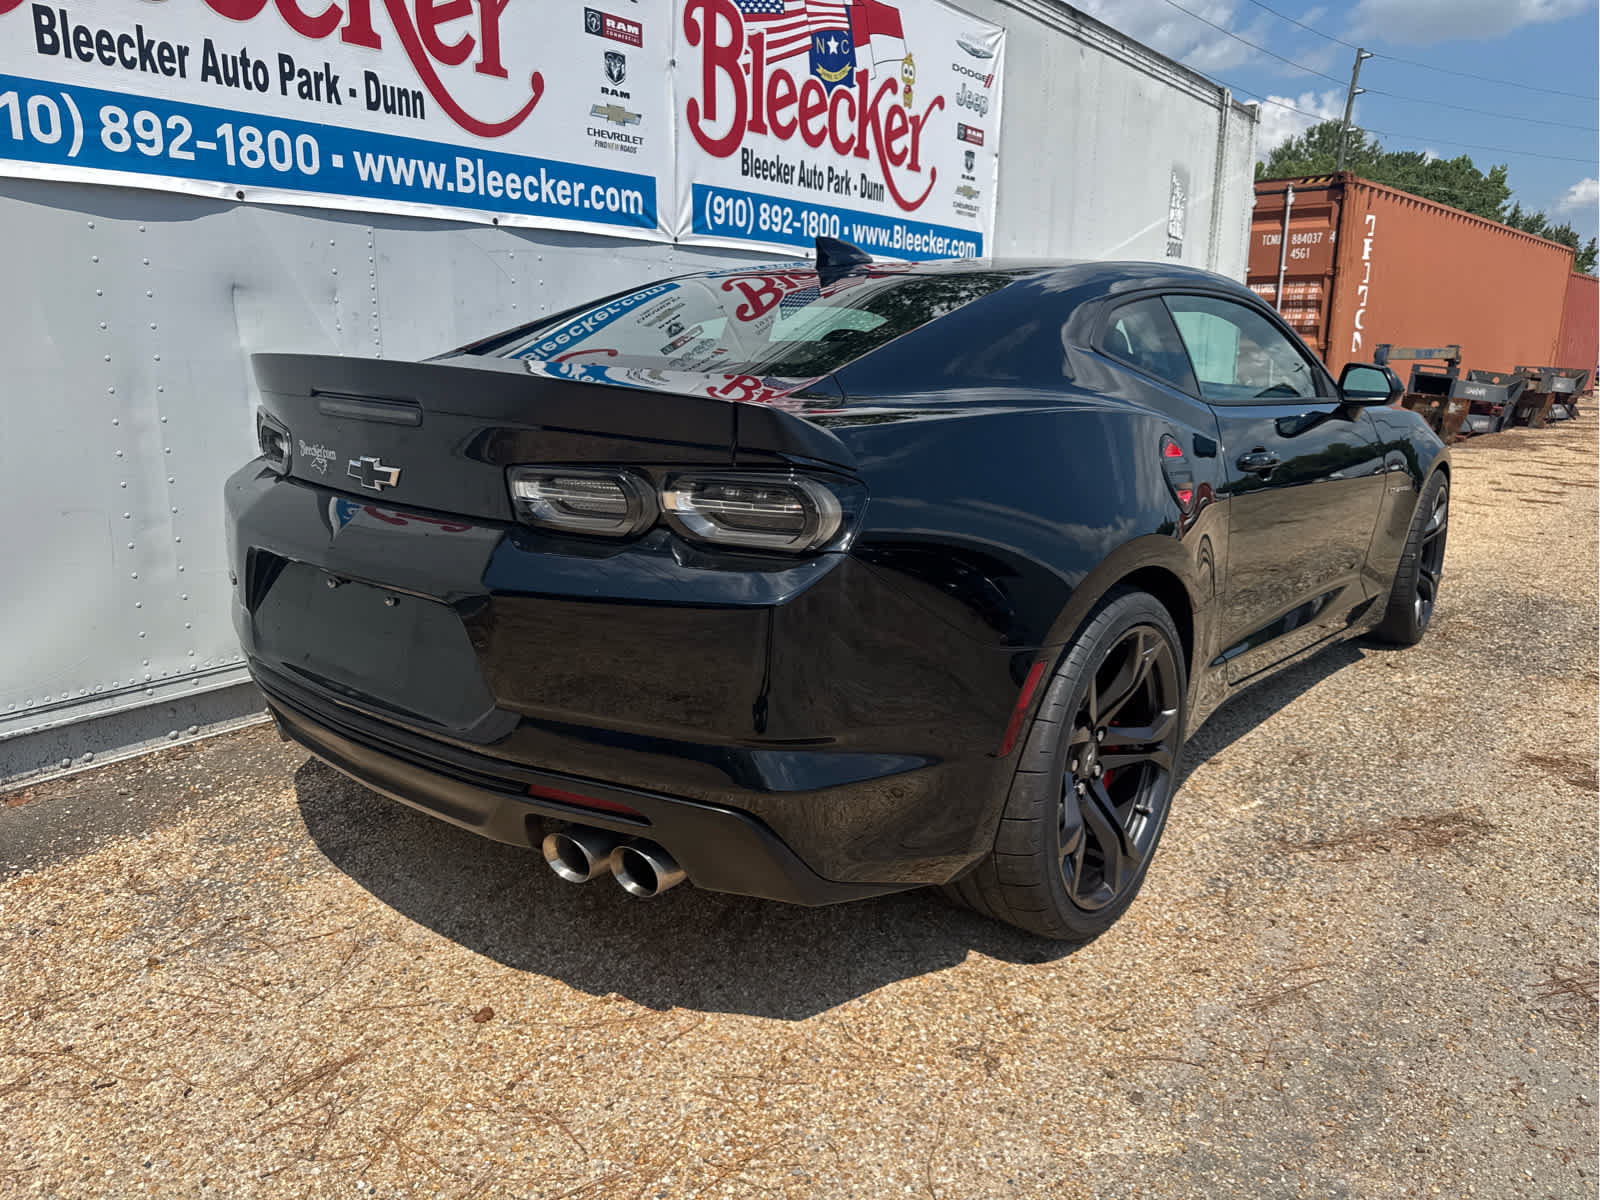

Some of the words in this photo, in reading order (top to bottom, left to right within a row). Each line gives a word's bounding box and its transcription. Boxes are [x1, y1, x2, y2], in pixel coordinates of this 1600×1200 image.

[606, 18, 639, 35] RAM
[32, 3, 190, 79] Bleecker
[201, 38, 269, 93] Auto
[278, 52, 342, 106] Park
[364, 70, 425, 120] Dunn
[952, 63, 987, 82] DODGE
[601, 86, 631, 100] RAM
[684, 0, 945, 212] Bleecker
[956, 82, 989, 118] Jeep
[586, 127, 644, 145] CHEVROLET
[99, 104, 320, 176] 892-1800
[353, 151, 643, 215] www.Bleecker.com
[741, 147, 796, 185] Bleecker
[798, 159, 824, 191] Auto
[827, 165, 852, 196] Park
[860, 172, 884, 202] Dunn
[705, 191, 755, 235] (910)
[759, 202, 840, 238] 892-1800
[853, 222, 977, 259] www.Bleecker.com
[1291, 232, 1323, 245] 884037
